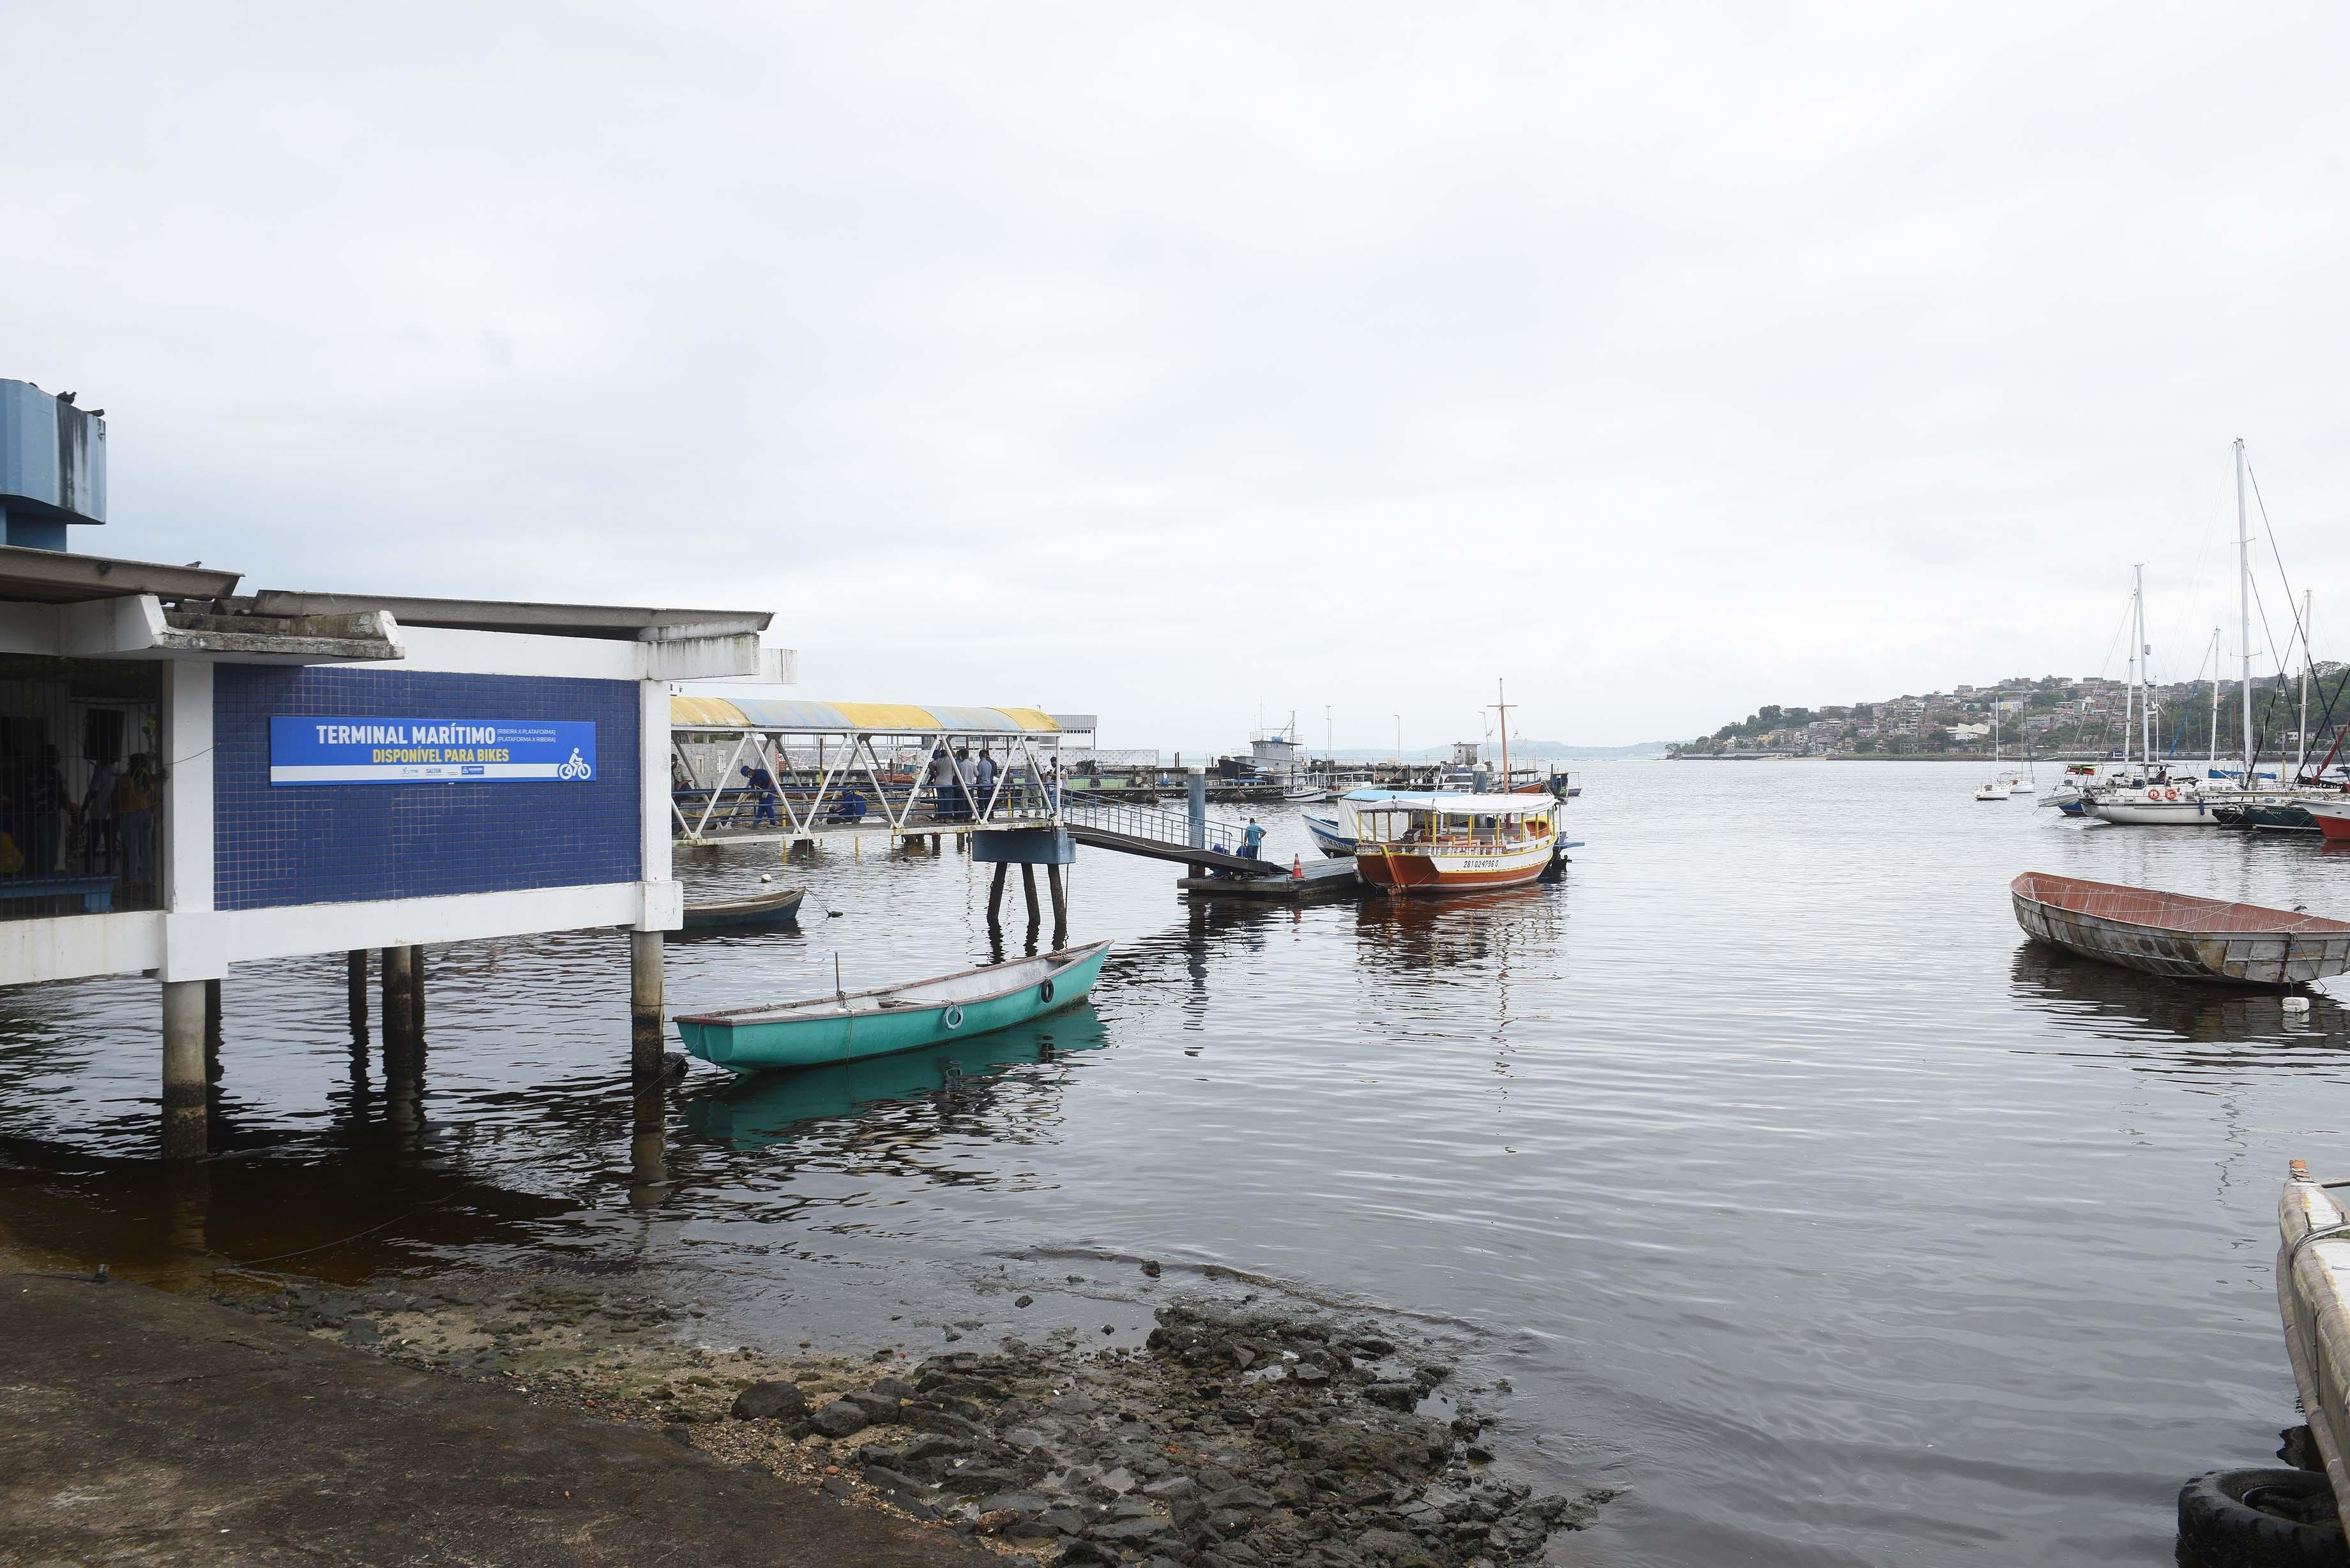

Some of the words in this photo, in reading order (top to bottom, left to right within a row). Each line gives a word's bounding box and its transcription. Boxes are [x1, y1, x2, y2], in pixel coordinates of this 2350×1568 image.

[316, 725, 408, 744] TERMINAL
[412, 722, 496, 744] MARÍTIMO
[373, 746, 442, 763] DISPONÍVEL
[444, 748, 474, 762] PARA
[478, 748, 510, 762] BIKES
